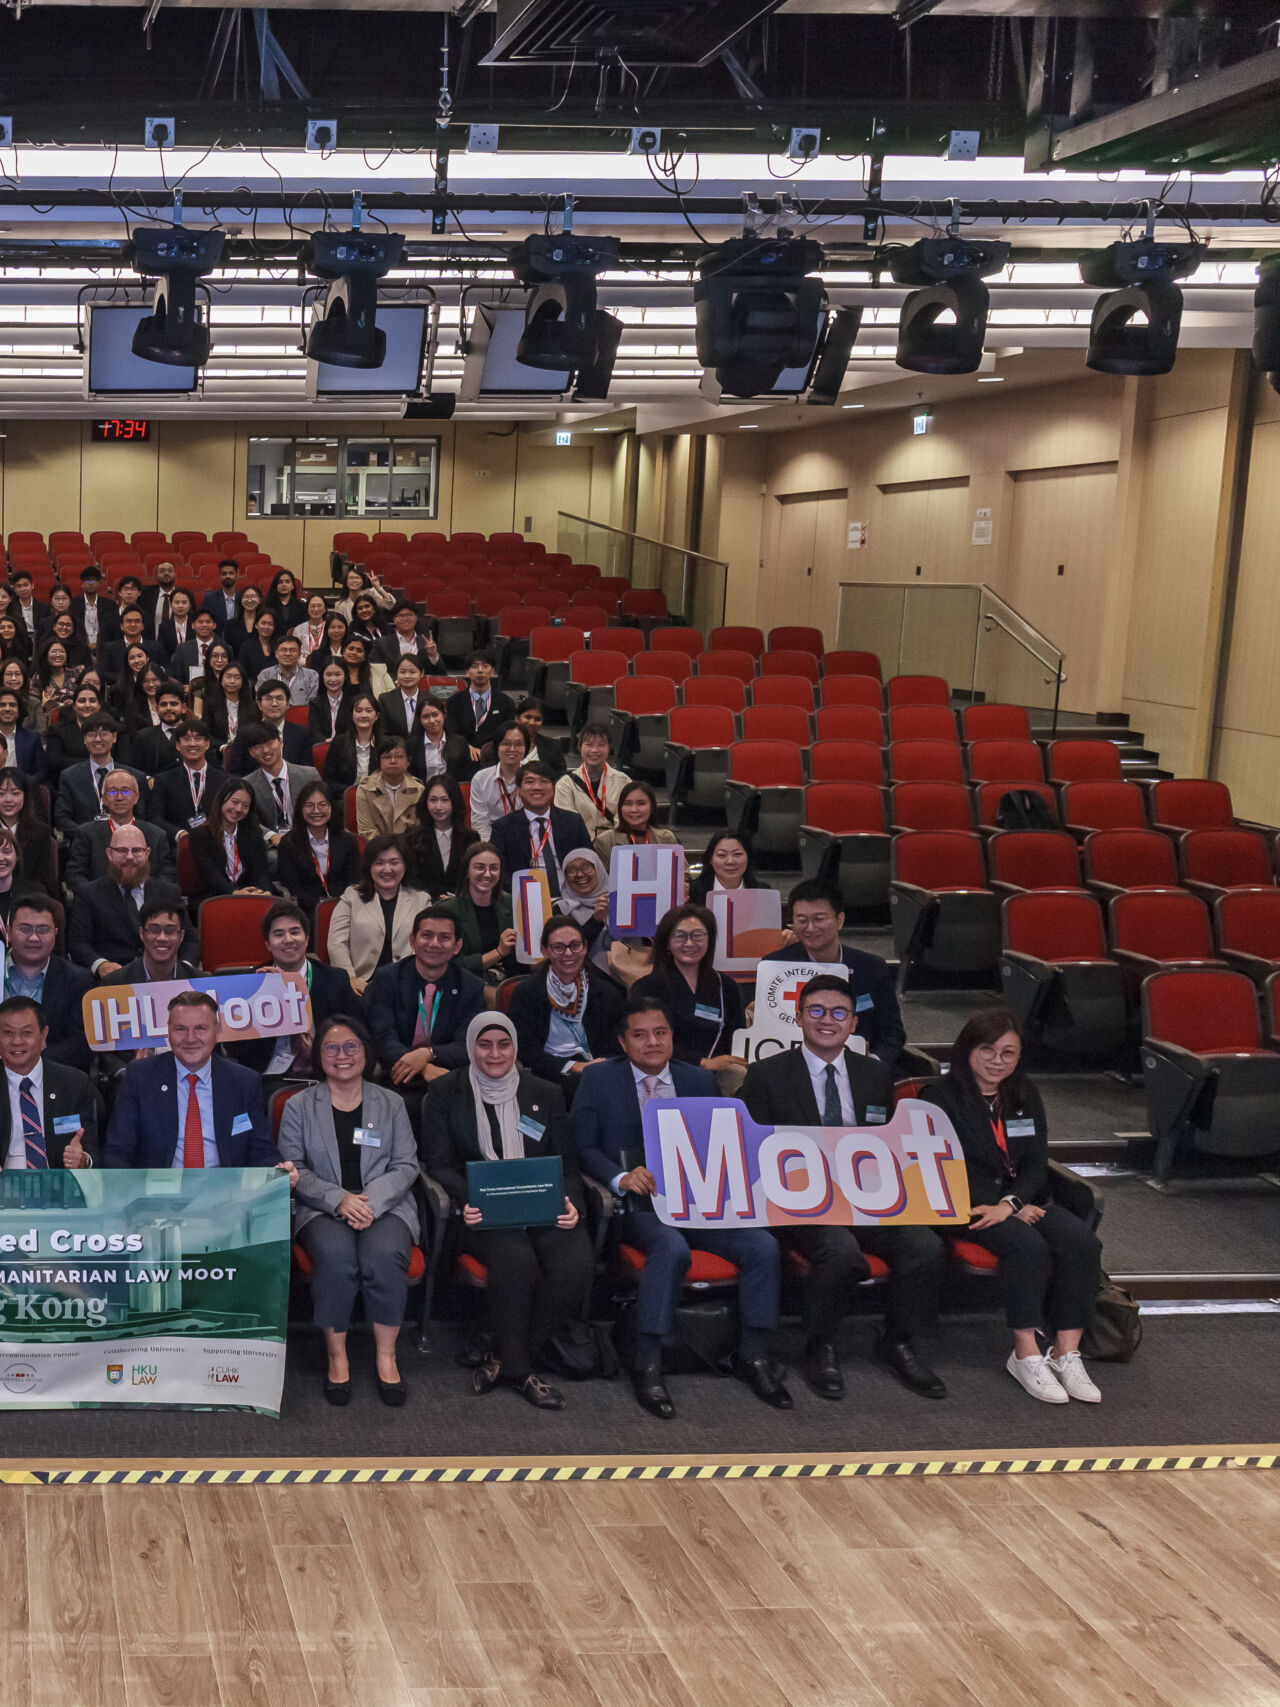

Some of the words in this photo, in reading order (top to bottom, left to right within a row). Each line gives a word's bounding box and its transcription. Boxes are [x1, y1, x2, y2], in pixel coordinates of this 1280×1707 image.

[103, 419, 147, 438] 17:34
[767, 975, 784, 1009] COMITE
[784, 968, 820, 978] INTERN
[91, 994, 169, 1042] IHL
[208, 981, 307, 1031] oot
[657, 1107, 956, 1220] Moot
[49, 1229, 144, 1253] Cross
[125, 1268, 172, 1284] LAW
[177, 1267, 238, 1282] MOOT
[14, 1292, 108, 1327] Kong
[103, 1345, 148, 1355] Collaborating
[202, 1347, 241, 1356] Supporting
[131, 1364, 158, 1376] HKU
[215, 1366, 240, 1374] CUHK
[215, 1373, 240, 1383] LAW
[131, 1375, 158, 1386] LAW
